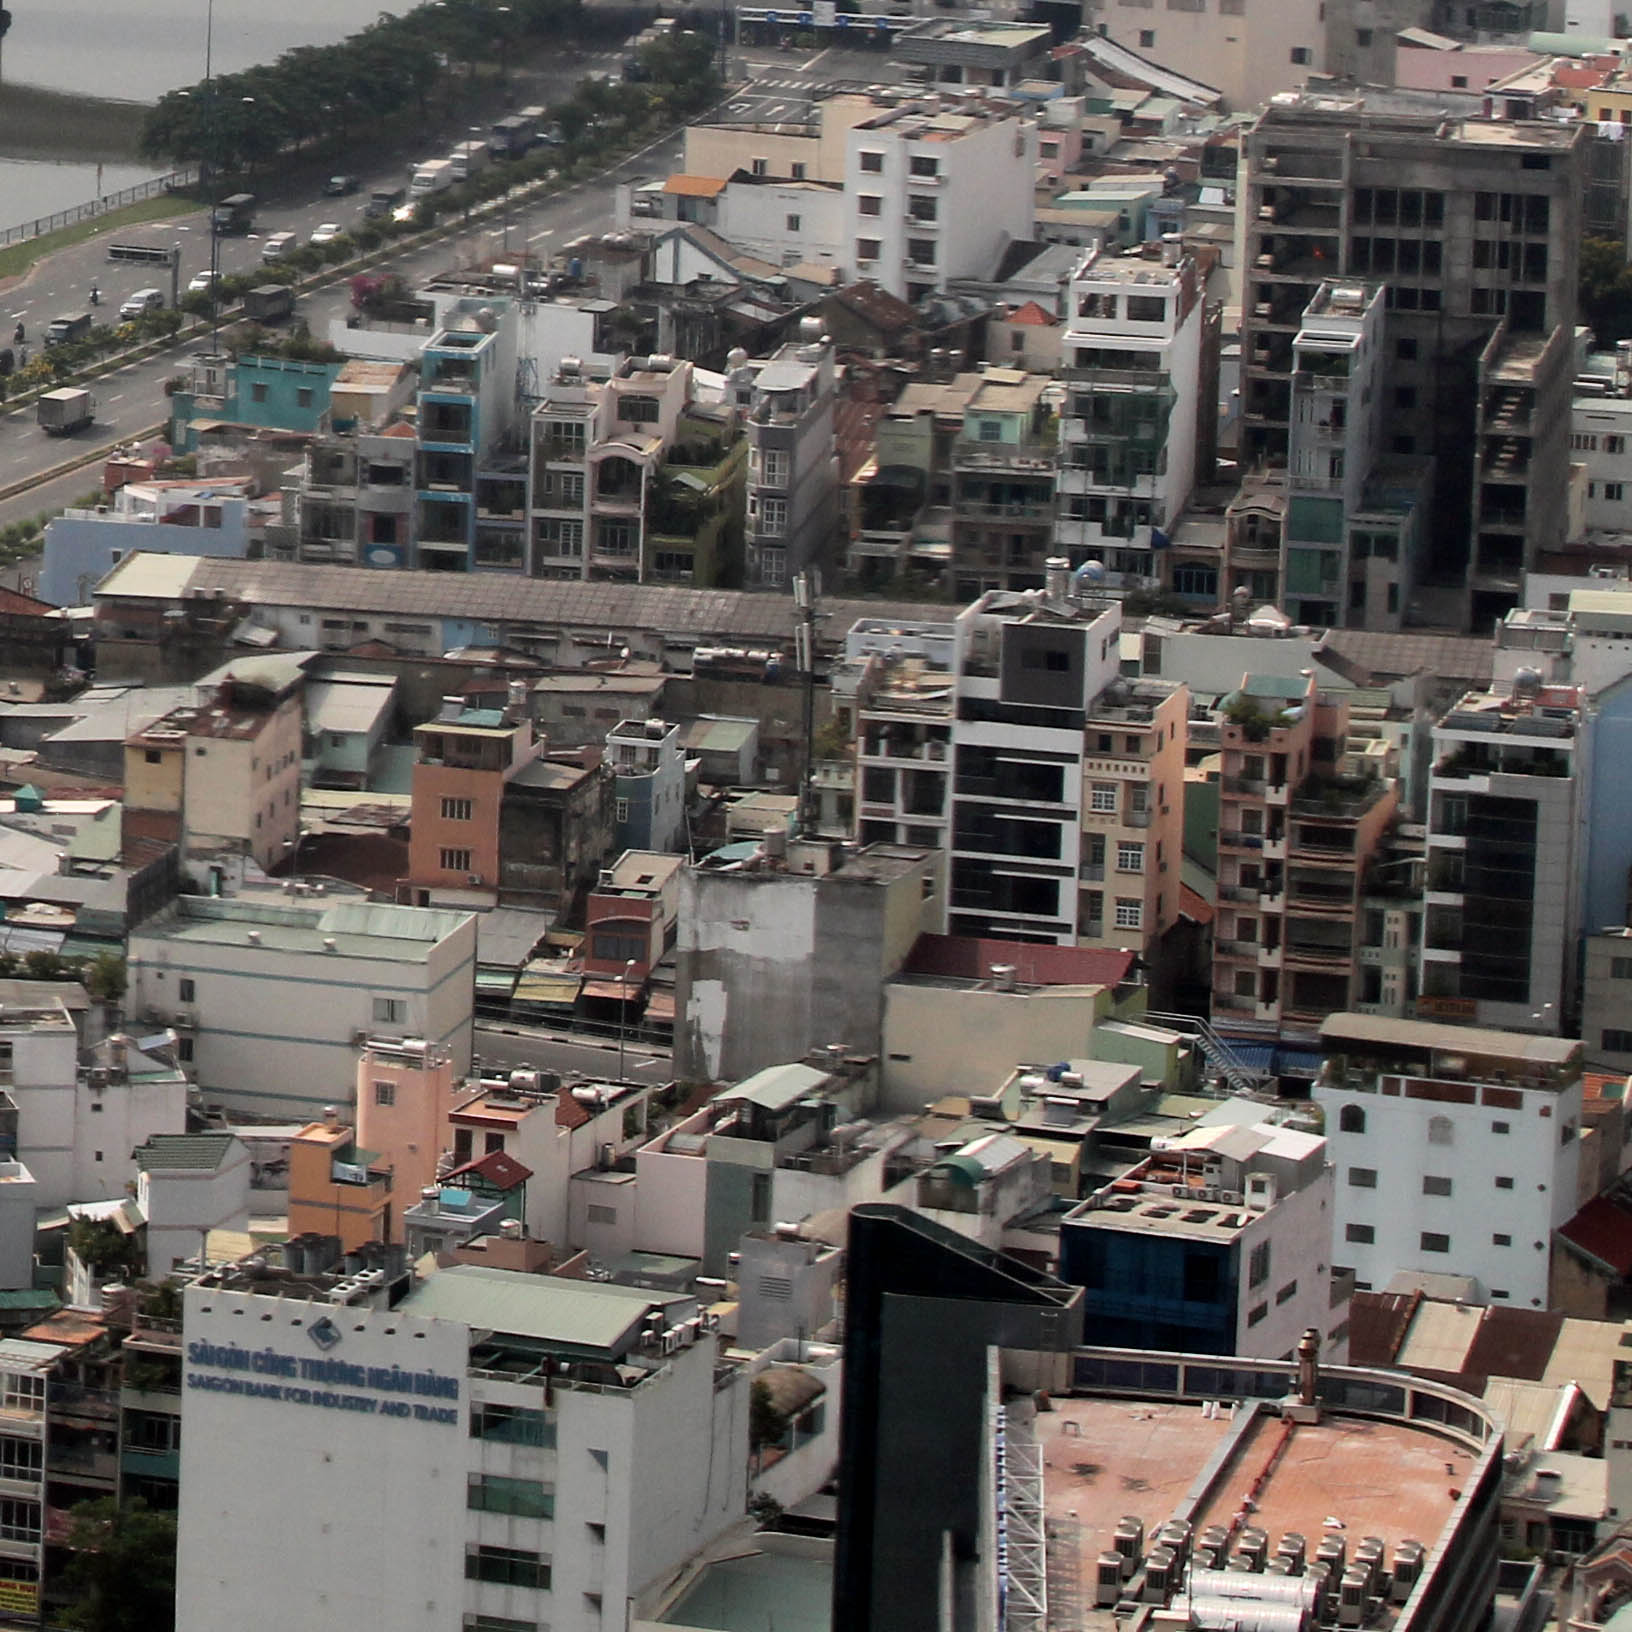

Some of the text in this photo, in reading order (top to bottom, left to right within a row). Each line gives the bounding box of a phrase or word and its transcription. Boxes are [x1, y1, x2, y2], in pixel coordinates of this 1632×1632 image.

[187, 1373, 458, 1426] SAIGON BANK FOR INDUSTRY AND TRADE
